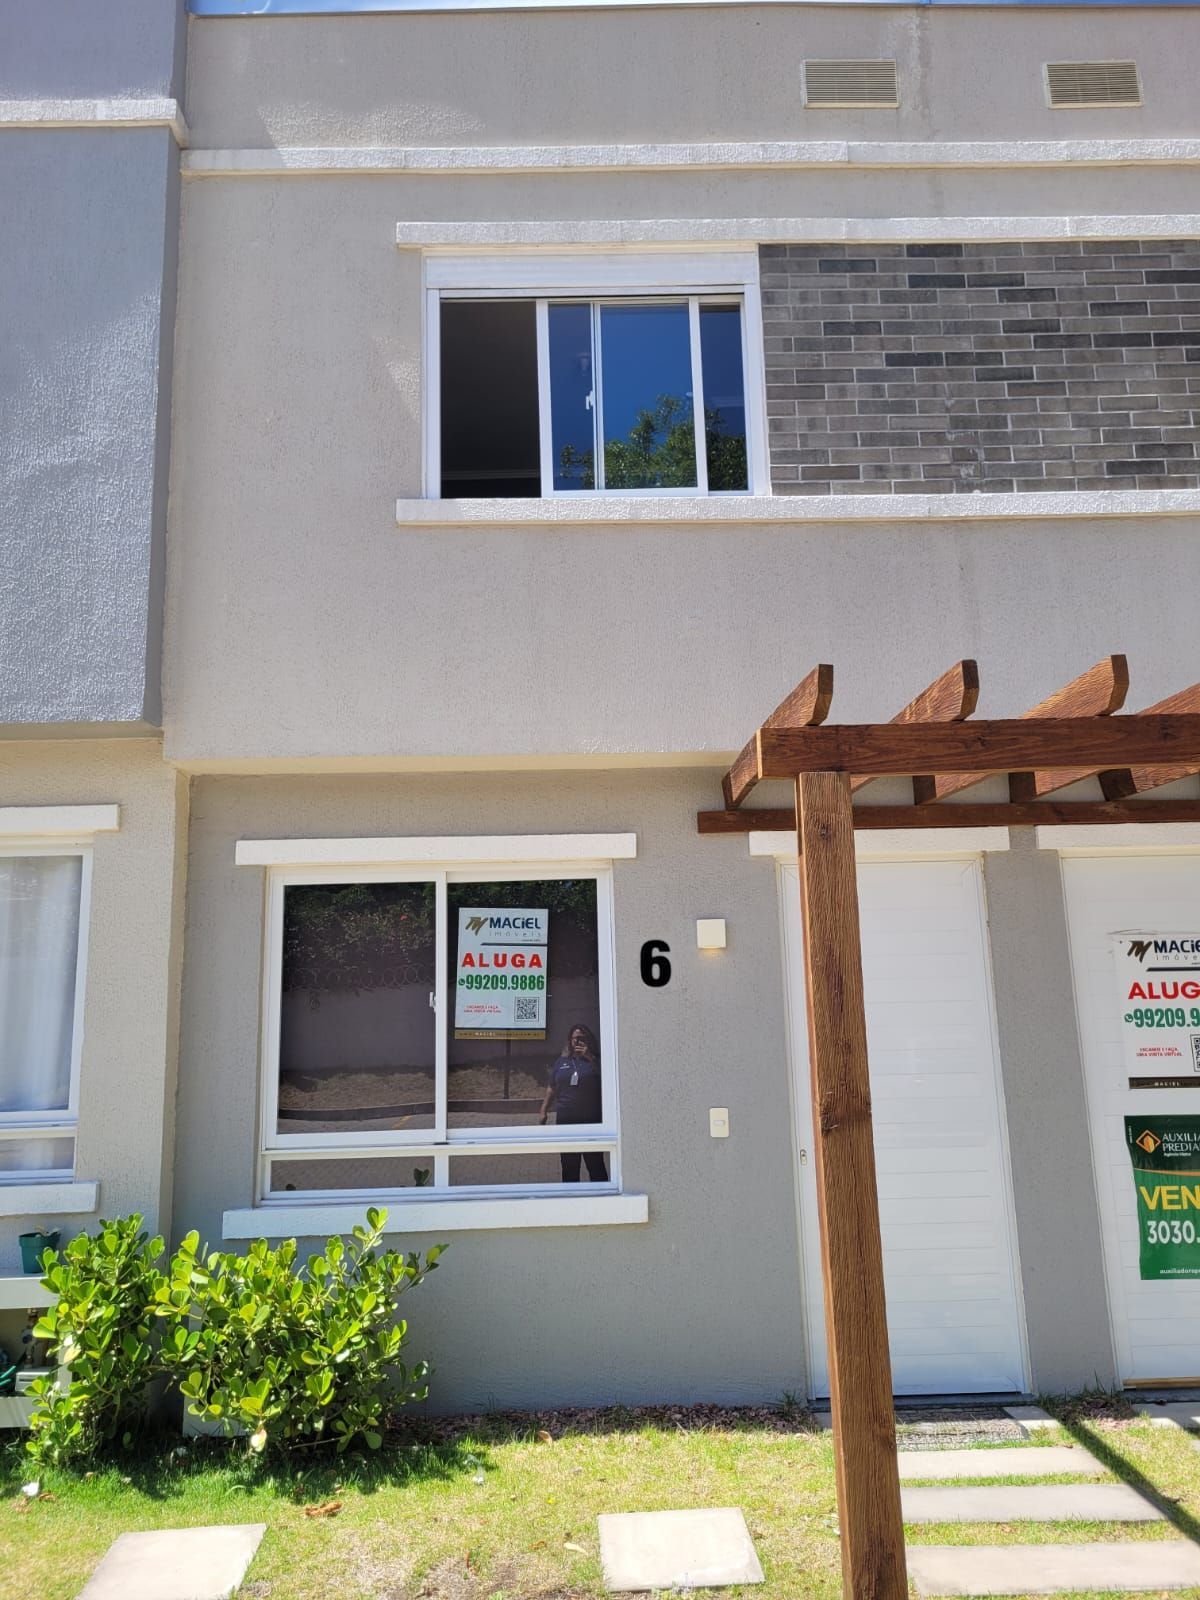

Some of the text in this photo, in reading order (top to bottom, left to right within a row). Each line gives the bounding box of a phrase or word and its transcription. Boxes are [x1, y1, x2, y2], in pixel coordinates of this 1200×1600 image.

[461, 952, 543, 969] ALUGA
[640, 939, 672, 988] 6
[465, 974, 545, 992] 99209.9886
[1128, 981, 1200, 1000] ALUG
[1133, 1008, 1200, 1028] 99209.9
[1140, 1185, 1200, 1210] VEN
